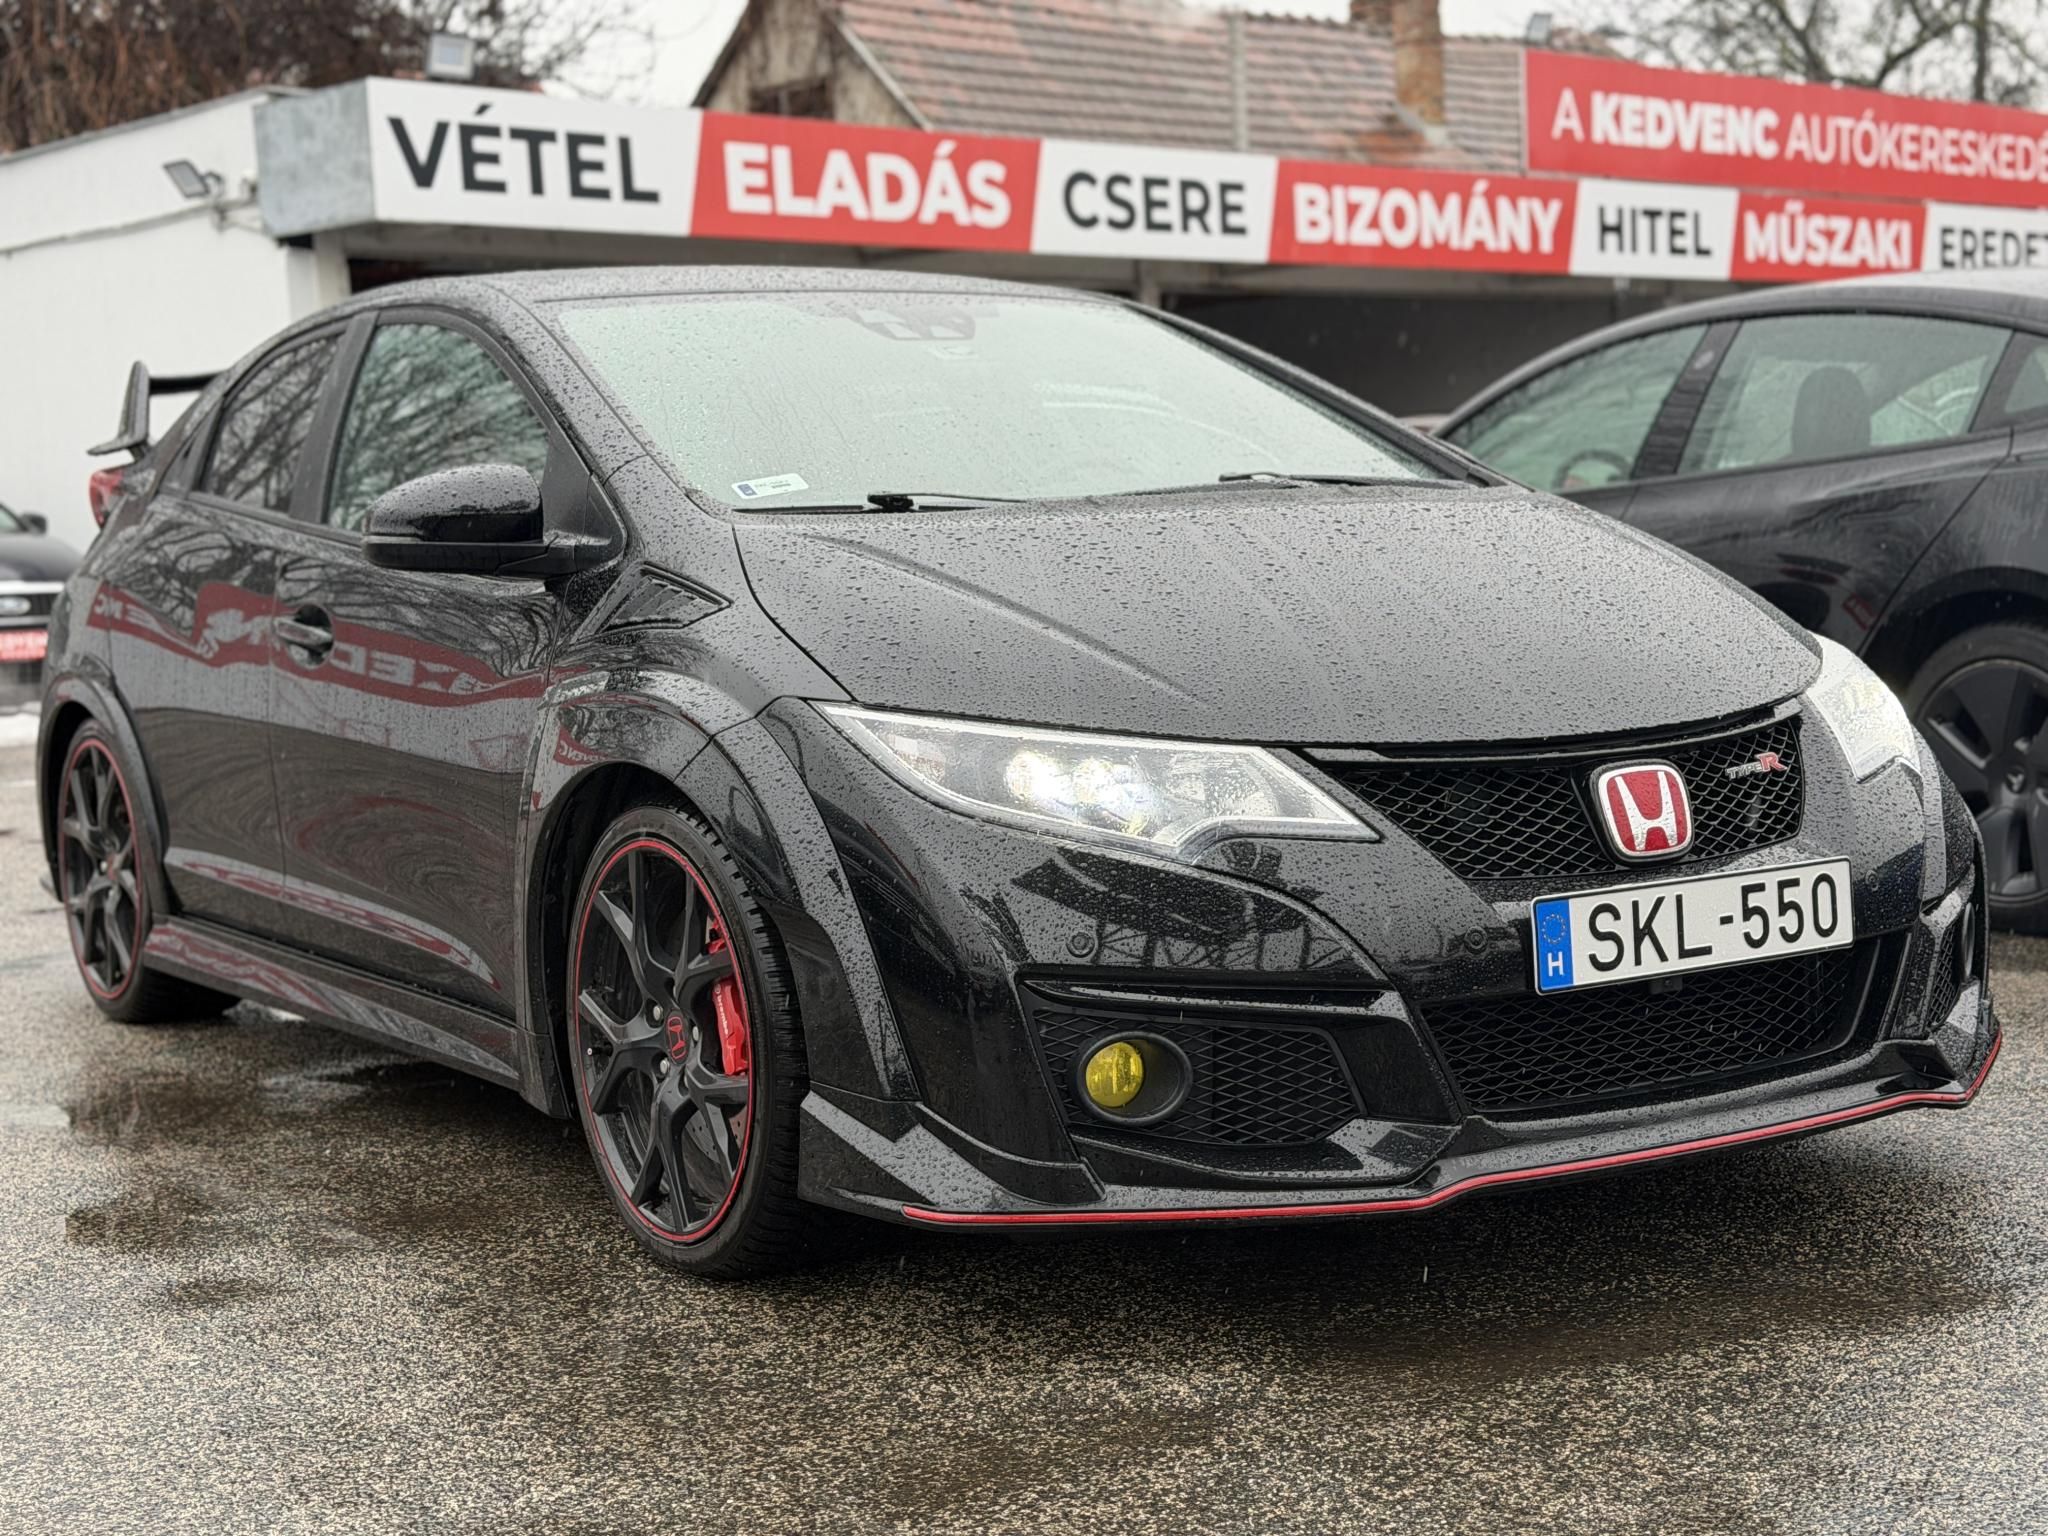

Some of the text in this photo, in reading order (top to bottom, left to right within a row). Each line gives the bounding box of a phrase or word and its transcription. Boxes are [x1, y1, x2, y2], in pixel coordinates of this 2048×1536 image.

[387, 103, 660, 203] VÉTEL
[1551, 88, 1584, 142] A
[1591, 91, 1779, 160] KEDVENC
[723, 140, 1012, 230] ELADÁS
[1064, 171, 1249, 237] CSERE
[1292, 181, 1563, 254] BIZOMÁNY
[1598, 205, 1713, 258] HITEL
[1743, 201, 1913, 270] MŰSZAKI
[1725, 761, 1763, 779] TYPE
[1588, 872, 1838, 972] SKL-550
[1547, 951, 1565, 977] H
